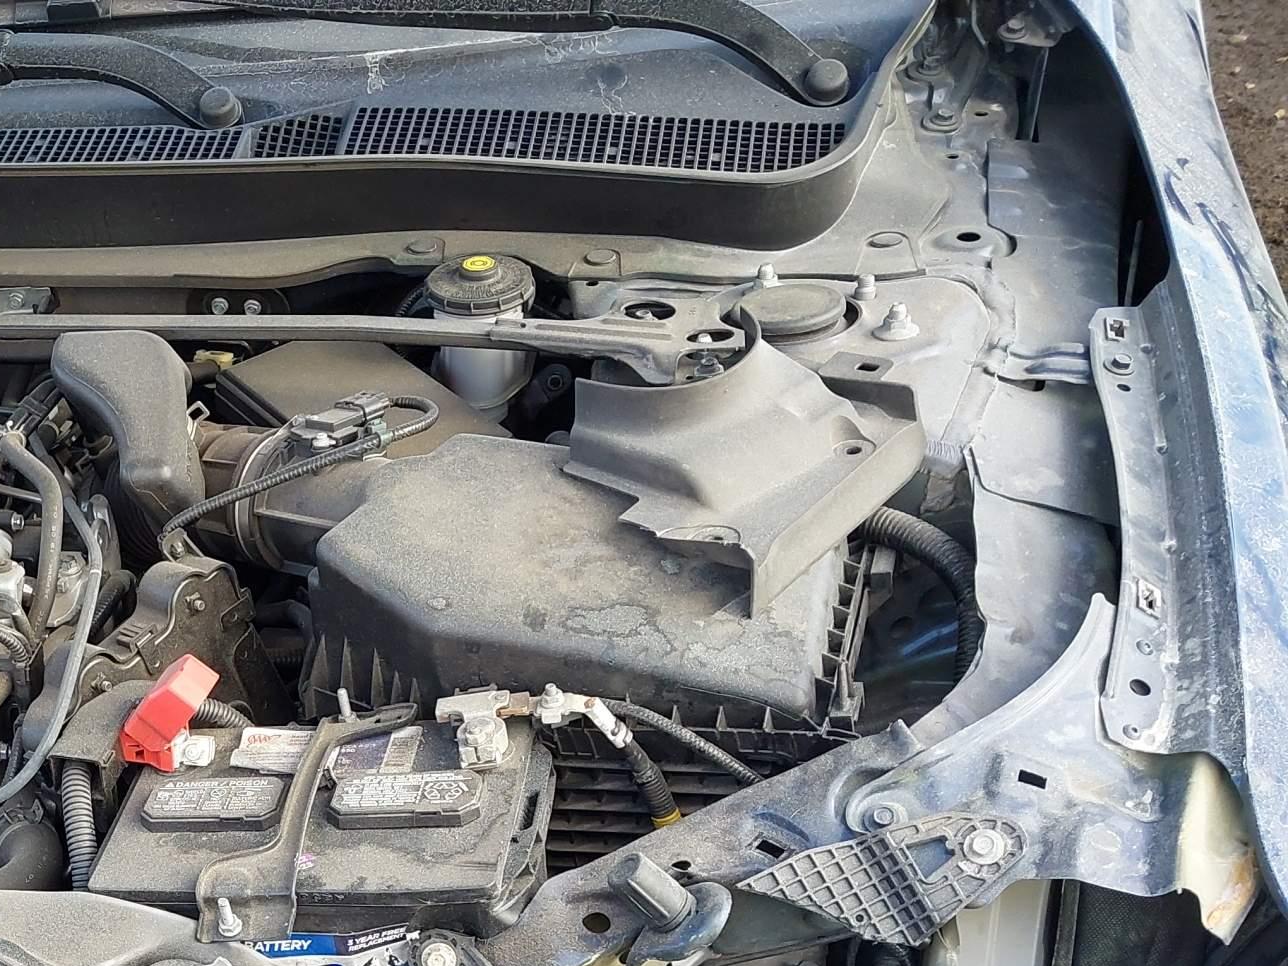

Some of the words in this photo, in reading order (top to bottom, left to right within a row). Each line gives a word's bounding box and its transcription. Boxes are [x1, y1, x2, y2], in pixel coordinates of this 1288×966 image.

[228, 779, 268, 787] POISON
[349, 933, 406, 952] REPLACEMENT
[355, 932, 380, 945] YEAR
[381, 926, 407, 938] FREE
[245, 940, 312, 952] BATTERY
